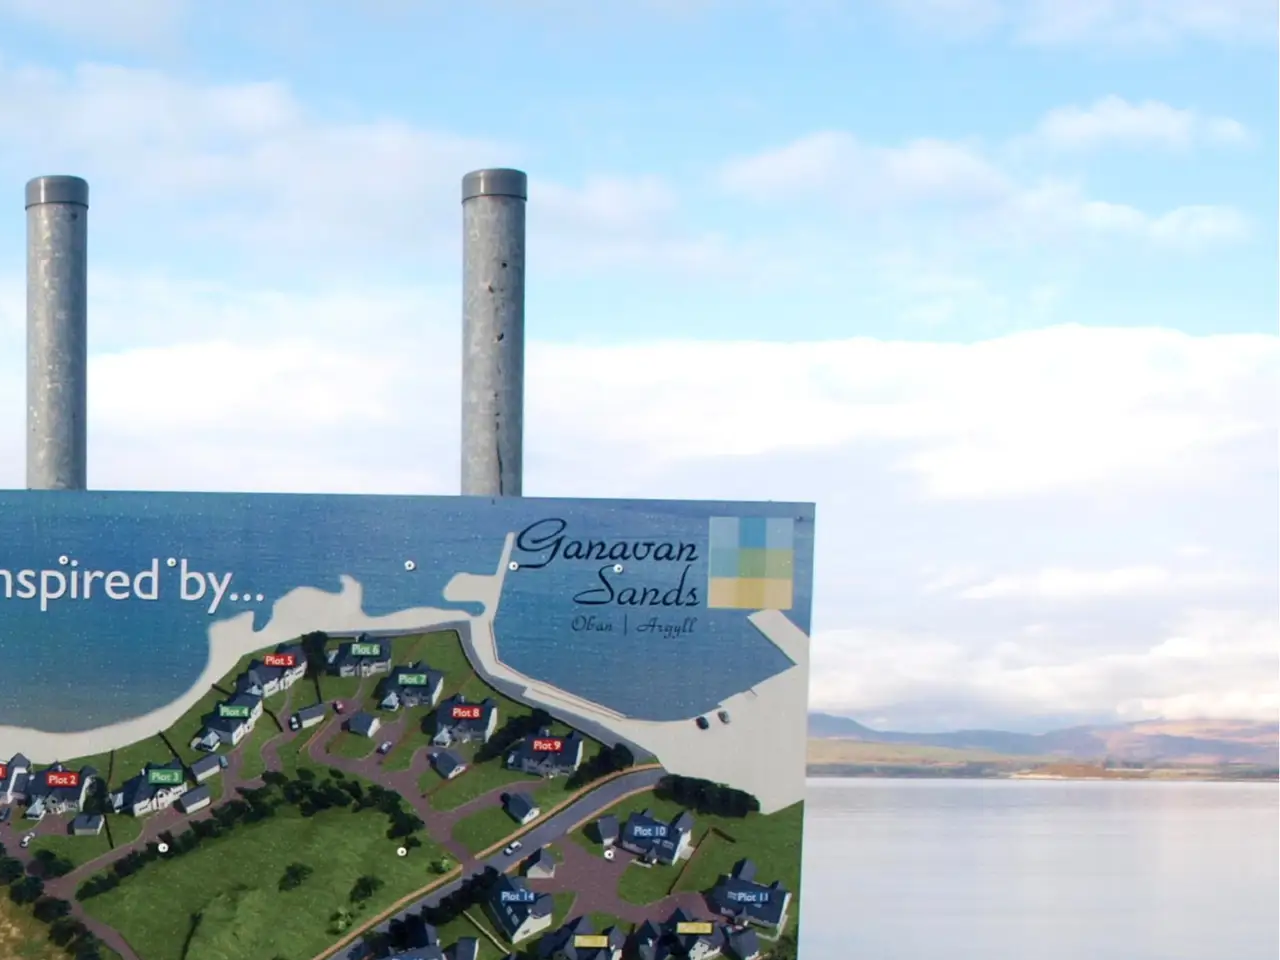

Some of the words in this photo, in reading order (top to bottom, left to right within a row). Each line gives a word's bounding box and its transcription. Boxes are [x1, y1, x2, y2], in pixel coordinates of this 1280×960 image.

[517, 518, 699, 568] Ganavan
[180, 558, 264, 614] by...
[572, 564, 701, 607] Sands
[571, 615, 613, 632] Oban
[636, 617, 698, 639] Argyll
[352, 644, 370, 654] Plot
[265, 655, 285, 665] Plot
[287, 655, 293, 665] 5
[398, 674, 417, 684] Plot
[221, 706, 240, 716] Plot
[452, 707, 471, 717] Plot
[533, 740, 551, 750] Plot
[552, 741, 561, 751] 9
[48, 774, 68, 784] Plot
[70, 775, 77, 784] 2
[152, 771, 172, 782] Plot
[173, 773, 179, 782] 3
[634, 825, 652, 836] Plot
[502, 891, 520, 901] Plot
[738, 891, 756, 901] Plot
